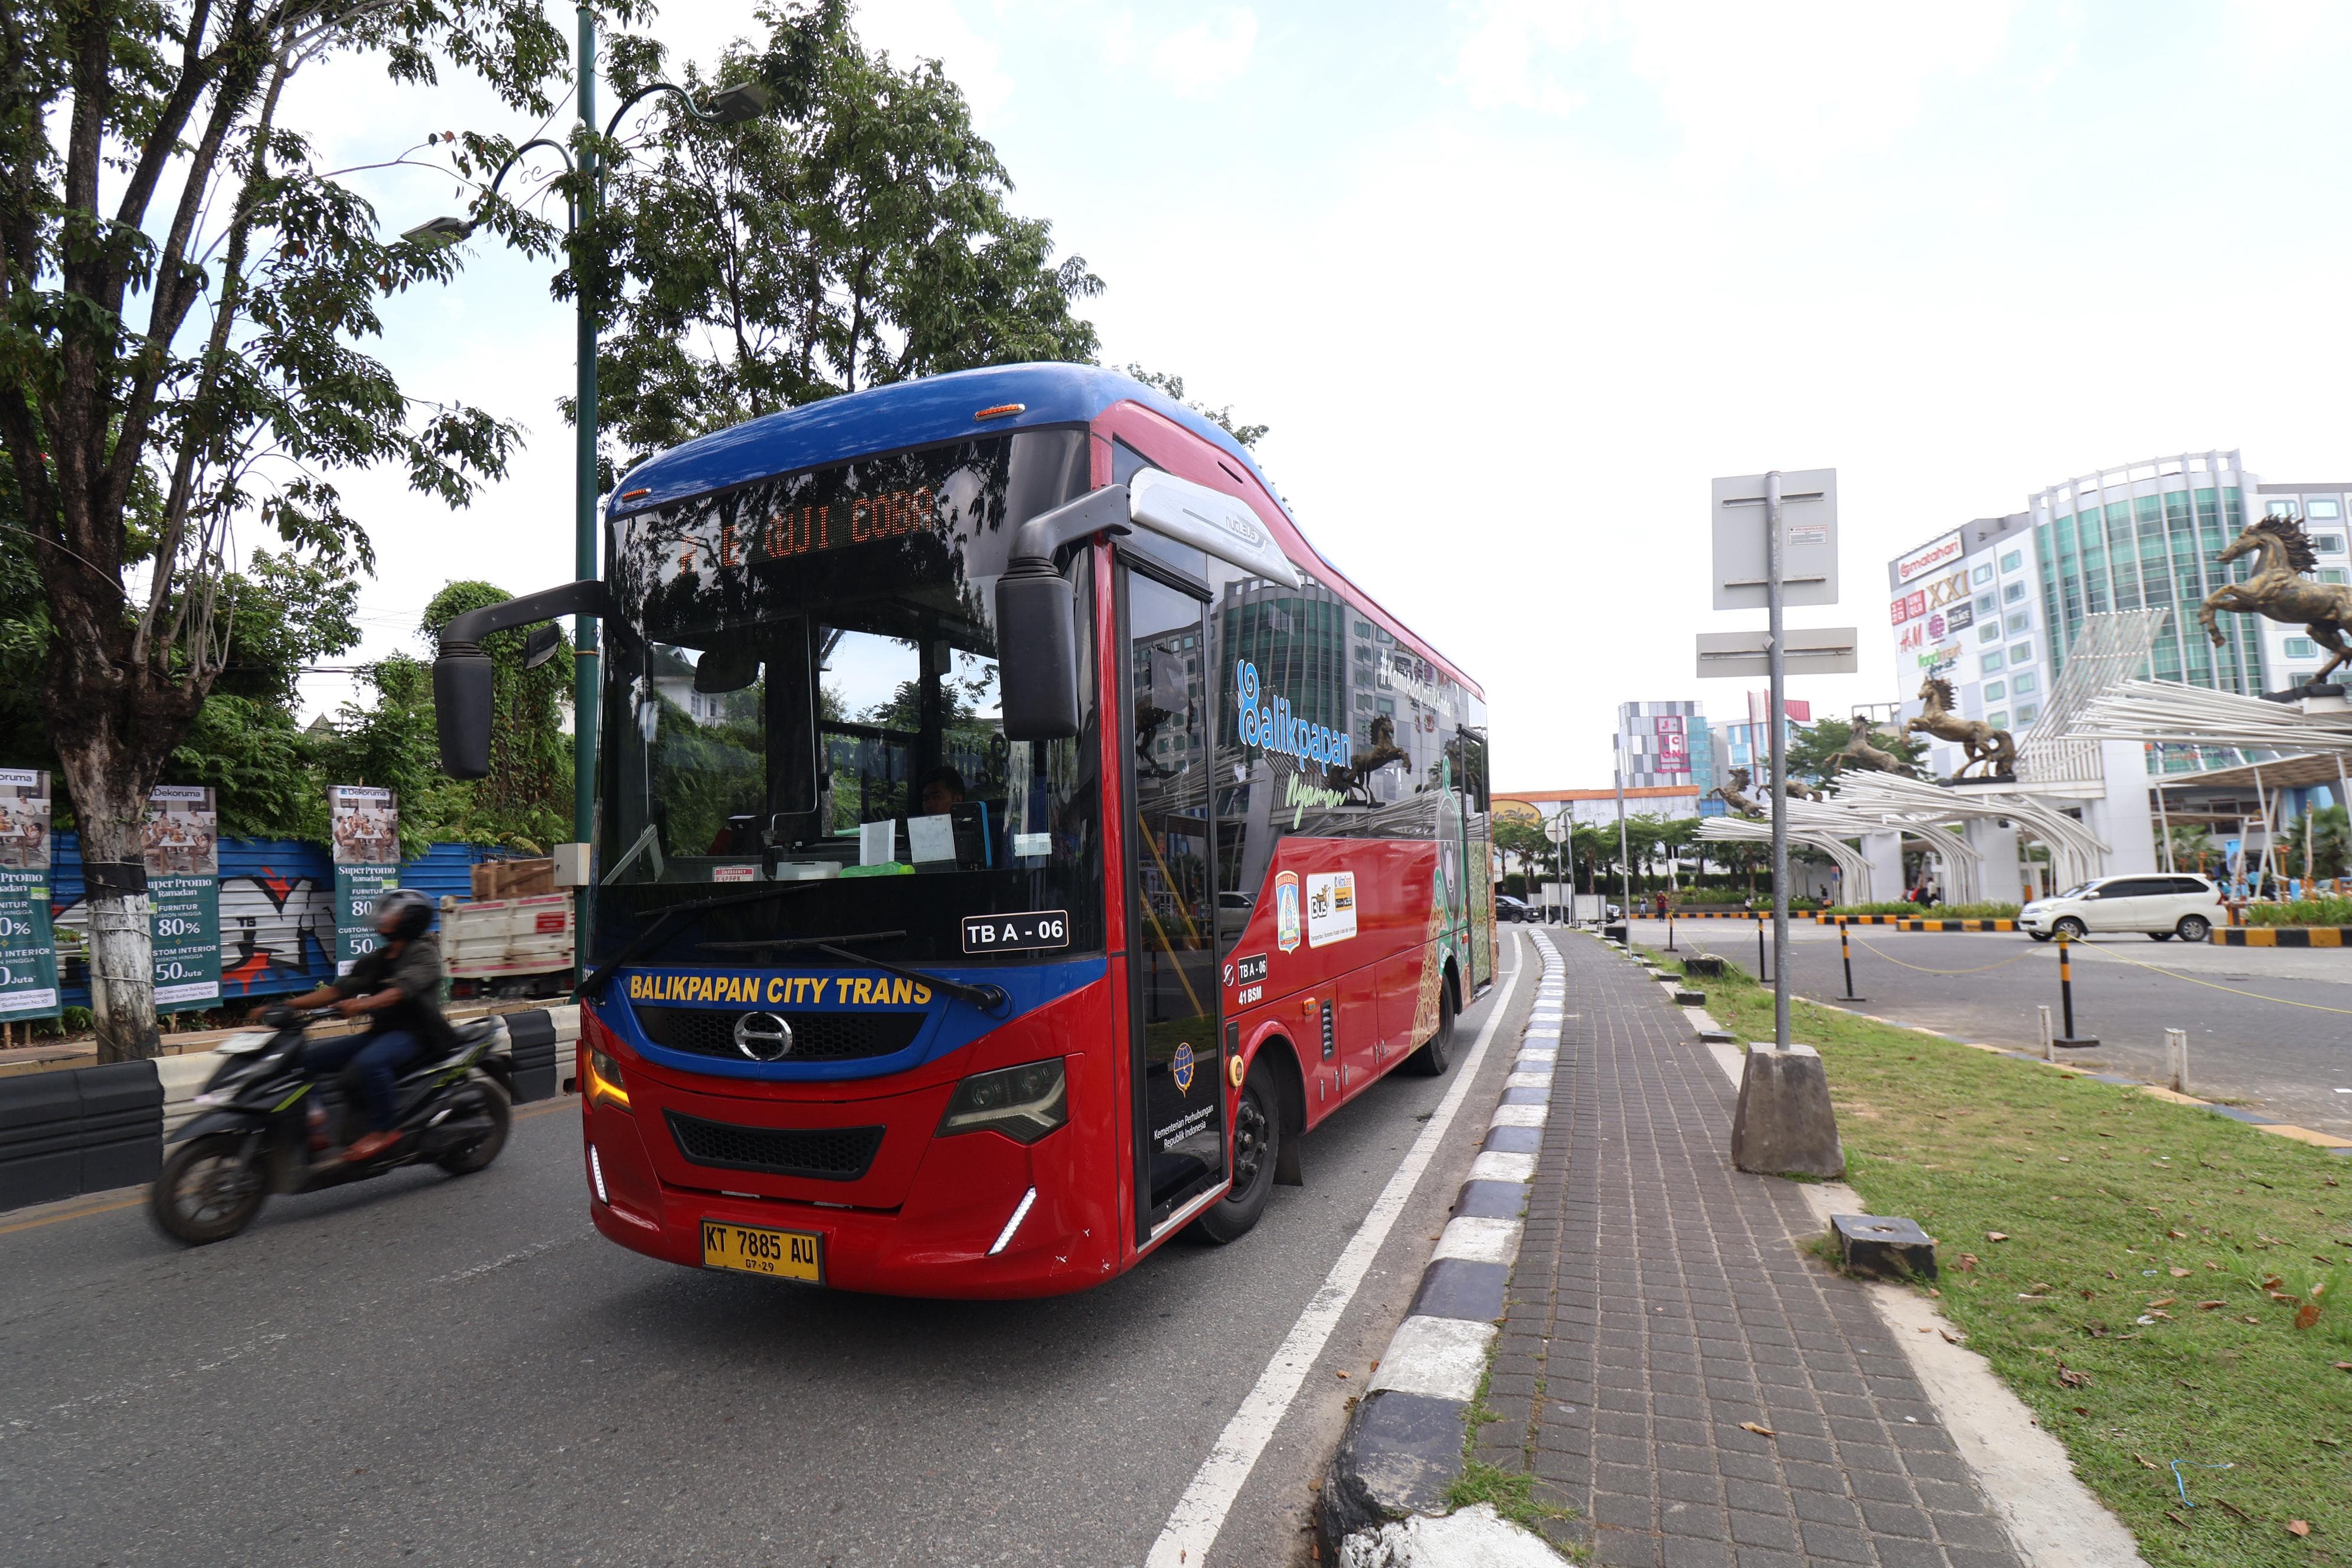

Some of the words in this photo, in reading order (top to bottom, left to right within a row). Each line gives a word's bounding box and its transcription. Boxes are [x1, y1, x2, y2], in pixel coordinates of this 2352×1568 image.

[1926, 569, 1971, 610] XXI
[1899, 622, 1922, 654] H&M
[1380, 648, 1451, 717] #KamiAdaUntukAnda
[1237, 659, 1352, 776] Balikpapan
[155, 789, 201, 797] Dekoruma
[1286, 769, 1347, 829] Nyaman
[1, 873, 43, 883] Promo
[338, 866, 364, 877] Super
[147, 880, 174, 890] uper
[175, 878, 212, 887] Promo
[158, 888, 197, 897] Ramadan
[352, 901, 374, 916] 80
[1311, 896, 1328, 919] Bus
[967, 925, 995, 943] TB
[1002, 923, 1018, 941] A
[1038, 920, 1063, 939] 06
[5, 948, 50, 957] INTERIOR
[152, 948, 177, 956] STOM
[178, 945, 217, 954] INTERIOR
[350, 939, 373, 954] 50
[155, 962, 182, 981] 50
[1239, 964, 1249, 978] TB
[1249, 963, 1255, 976] A
[1259, 960, 1266, 974] 06
[630, 975, 760, 1002] BALIKPAPAN
[767, 977, 829, 1003] CITY
[836, 978, 932, 1004] TRANS
[1239, 990, 1247, 1005] 41
[1247, 985, 1262, 1003] BSM
[1154, 1119, 1184, 1140] Kementerian
[1184, 1105, 1214, 1125] Perhubungan
[1164, 1130, 1185, 1149] Republik
[1185, 1120, 1206, 1138] Indonesia
[706, 1226, 727, 1252] KT
[737, 1230, 780, 1260] 7885
[791, 1237, 814, 1265] AU
